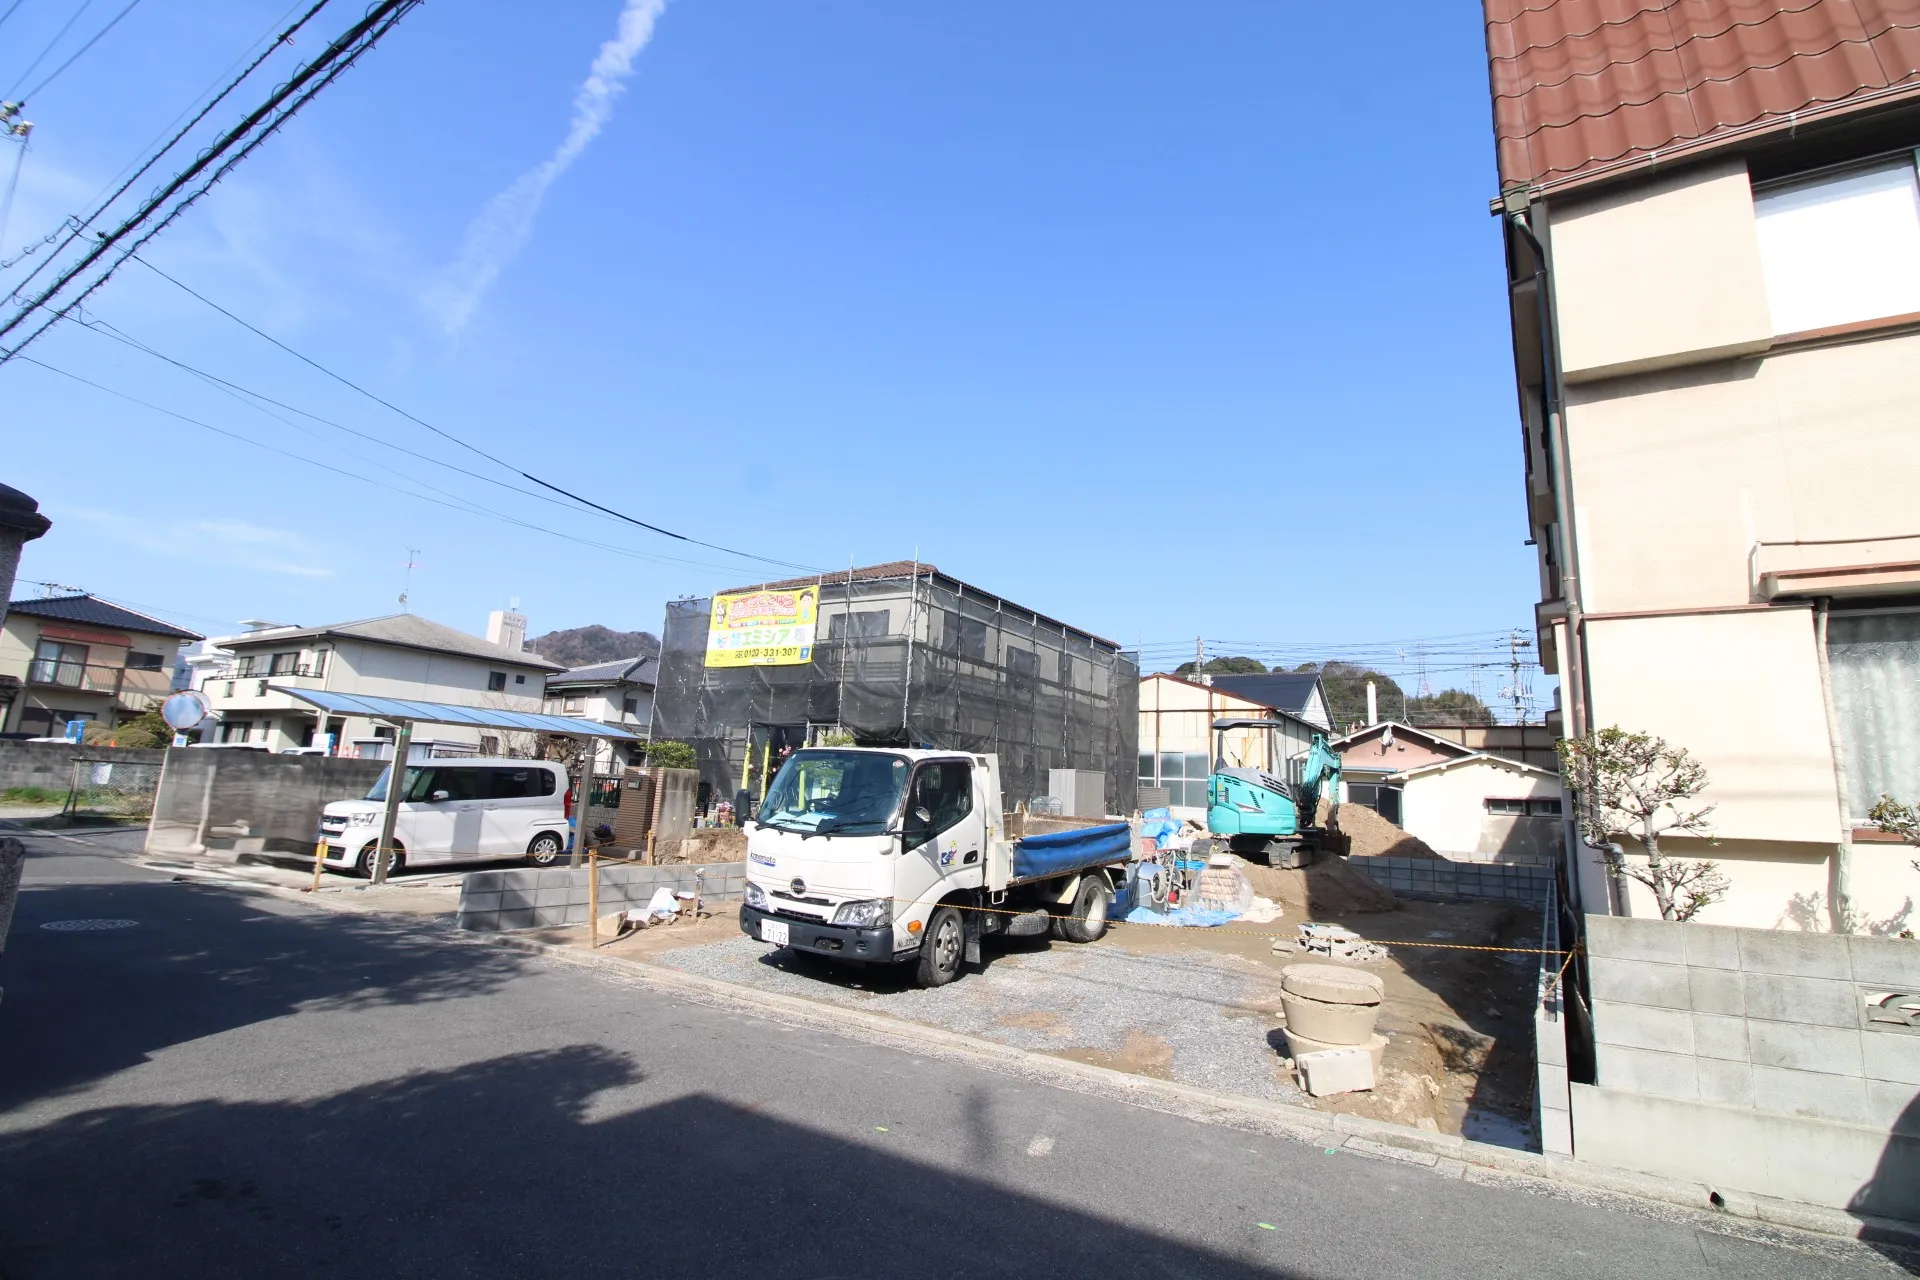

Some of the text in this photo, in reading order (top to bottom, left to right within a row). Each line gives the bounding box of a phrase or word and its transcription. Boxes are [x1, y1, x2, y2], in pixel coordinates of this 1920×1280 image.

[743, 629, 790, 645] エミシア
[744, 647, 798, 658] 0120-331-307
